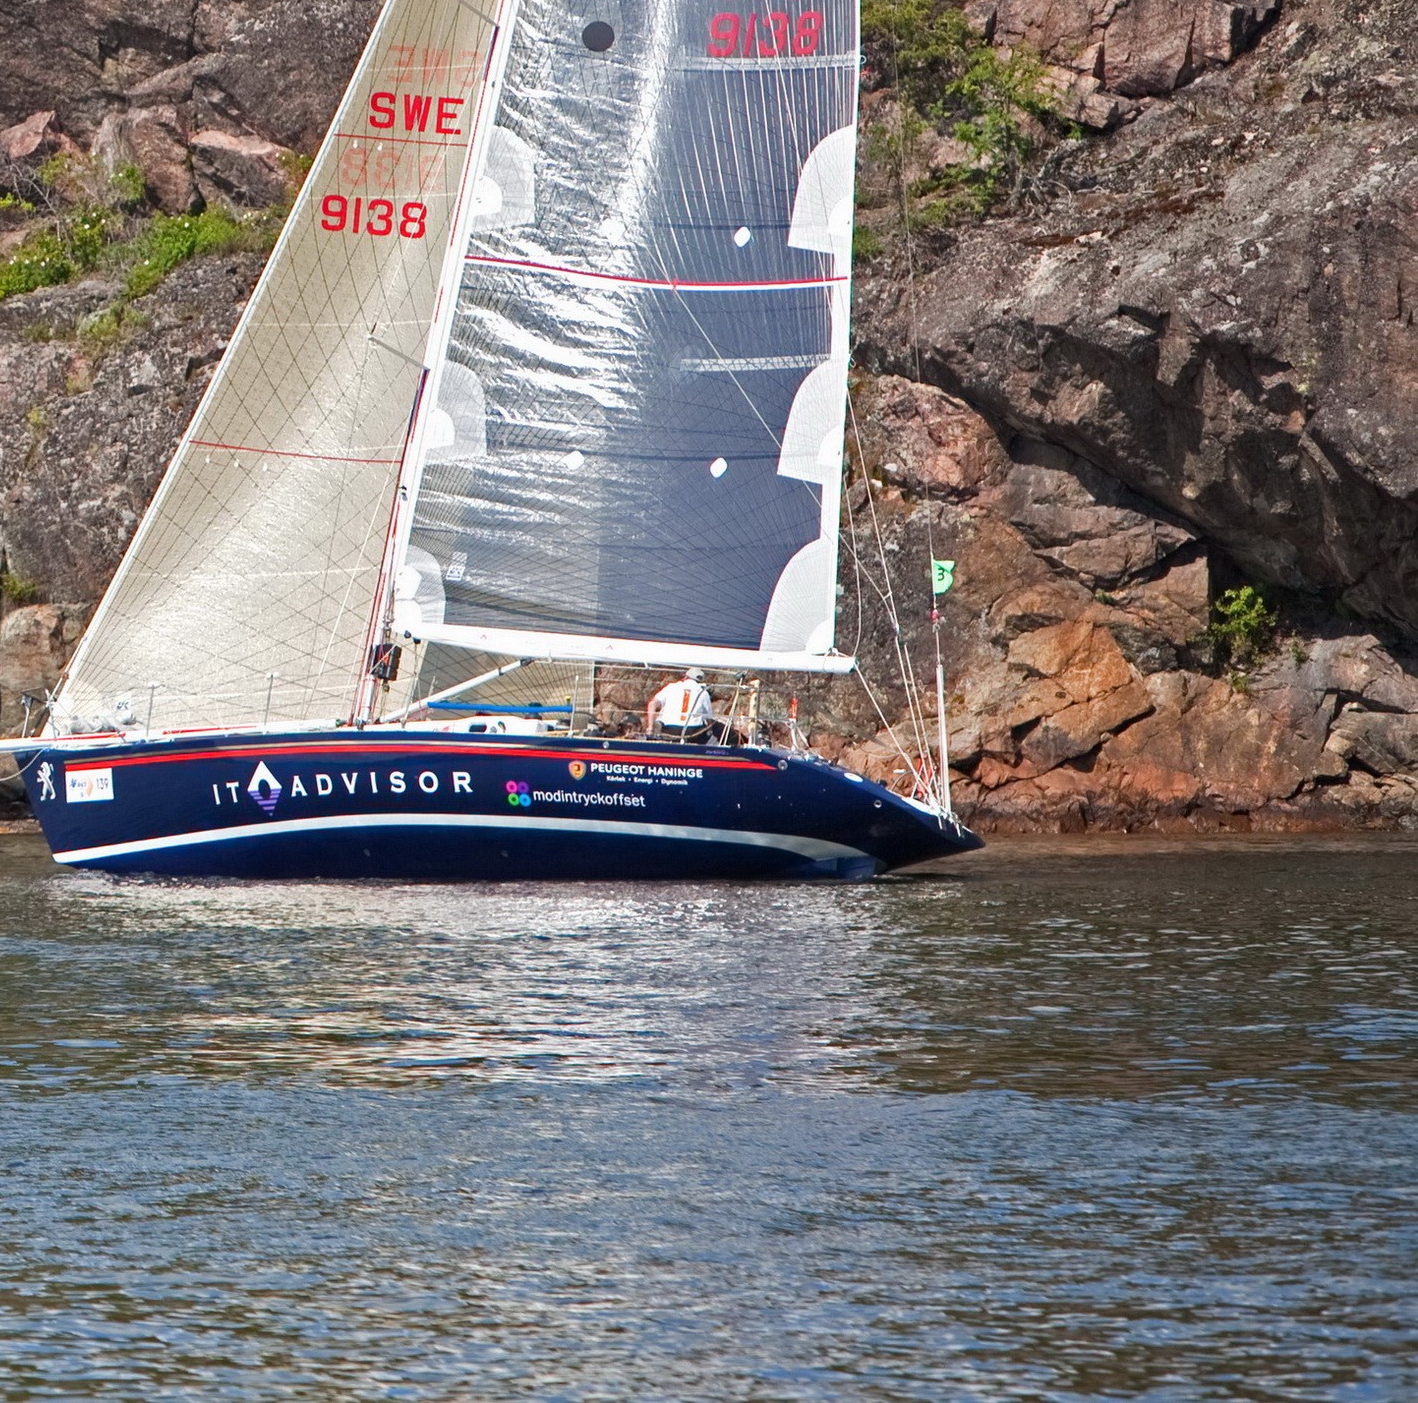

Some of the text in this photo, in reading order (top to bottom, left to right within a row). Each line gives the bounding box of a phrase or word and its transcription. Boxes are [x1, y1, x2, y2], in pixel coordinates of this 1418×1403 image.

[706, 10, 823, 58] 9138
[368, 91, 465, 135] SWE
[321, 194, 428, 239] 9138
[213, 771, 474, 805] IT ADVISOR
[590, 762, 703, 779] PEUGEOT HANINGE
[532, 789, 647, 808] modintryckoffset
